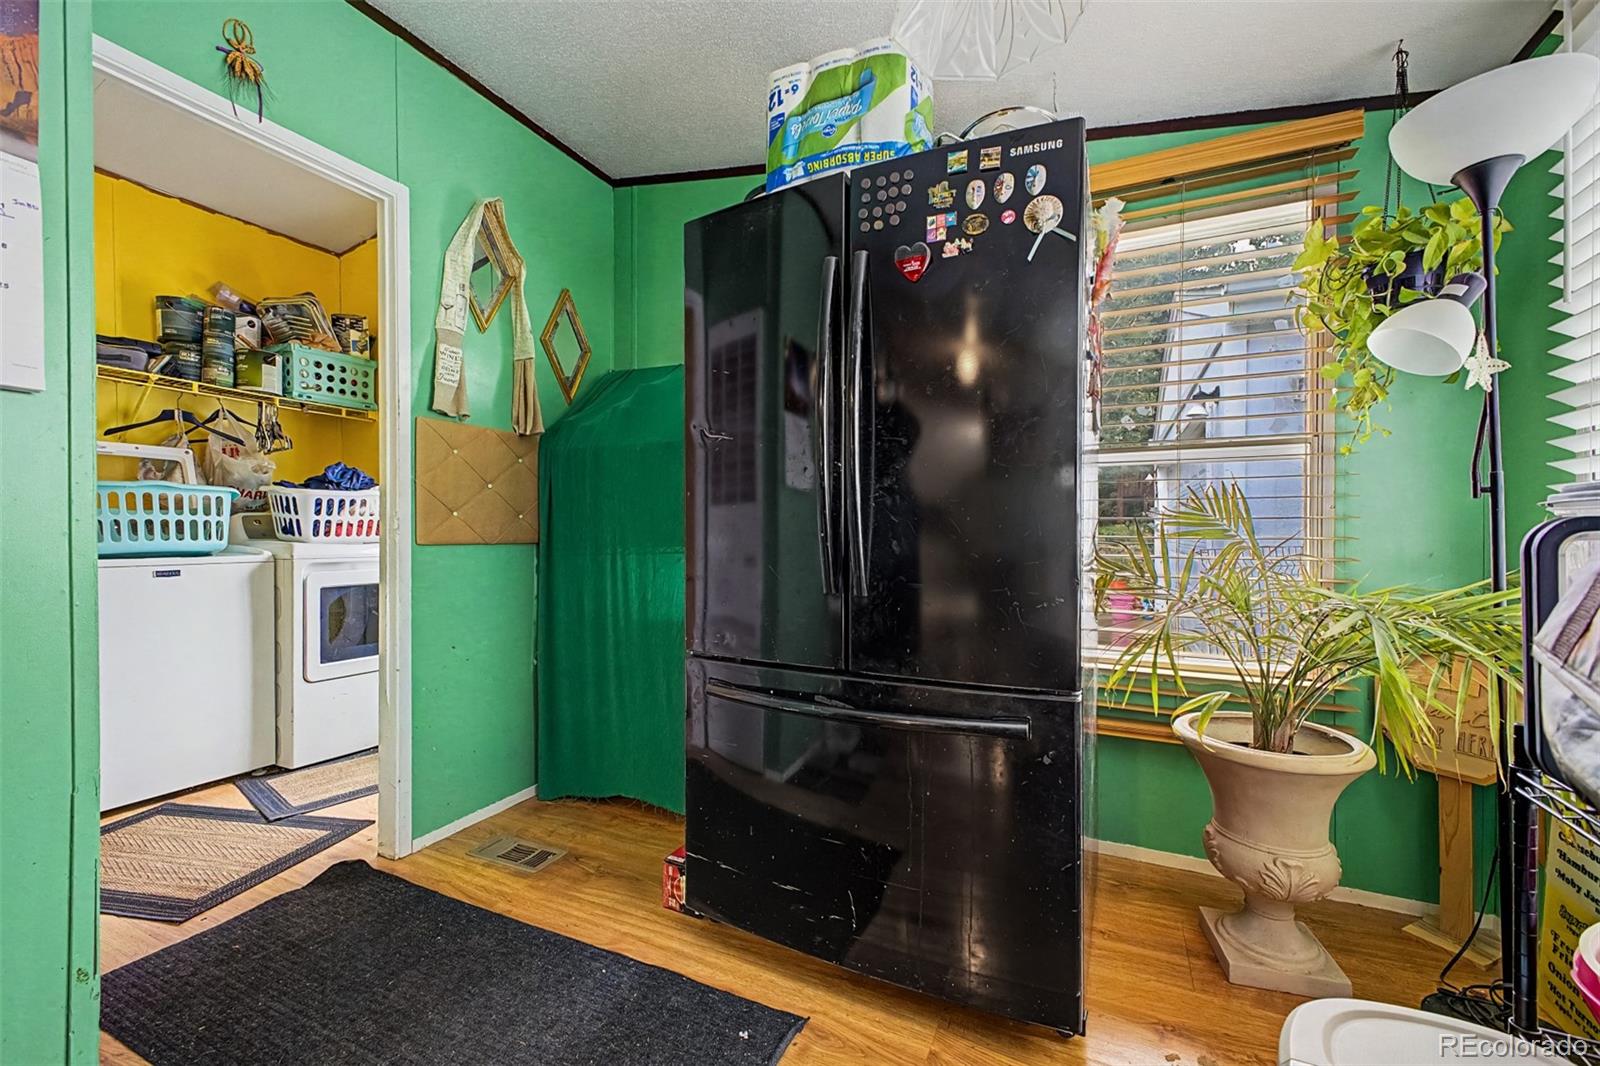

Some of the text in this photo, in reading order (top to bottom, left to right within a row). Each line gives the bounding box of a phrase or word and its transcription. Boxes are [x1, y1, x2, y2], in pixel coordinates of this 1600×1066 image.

[864, 150, 895, 161] SUPER
[1009, 139, 1063, 157] SAMSUNG
[807, 152, 860, 173] ABSORBING
[1557, 848, 1600, 886] Hambur
[1548, 961, 1580, 997] Onion
[1548, 980, 1566, 1004] Hot
[1569, 999, 1600, 1034] Turno
